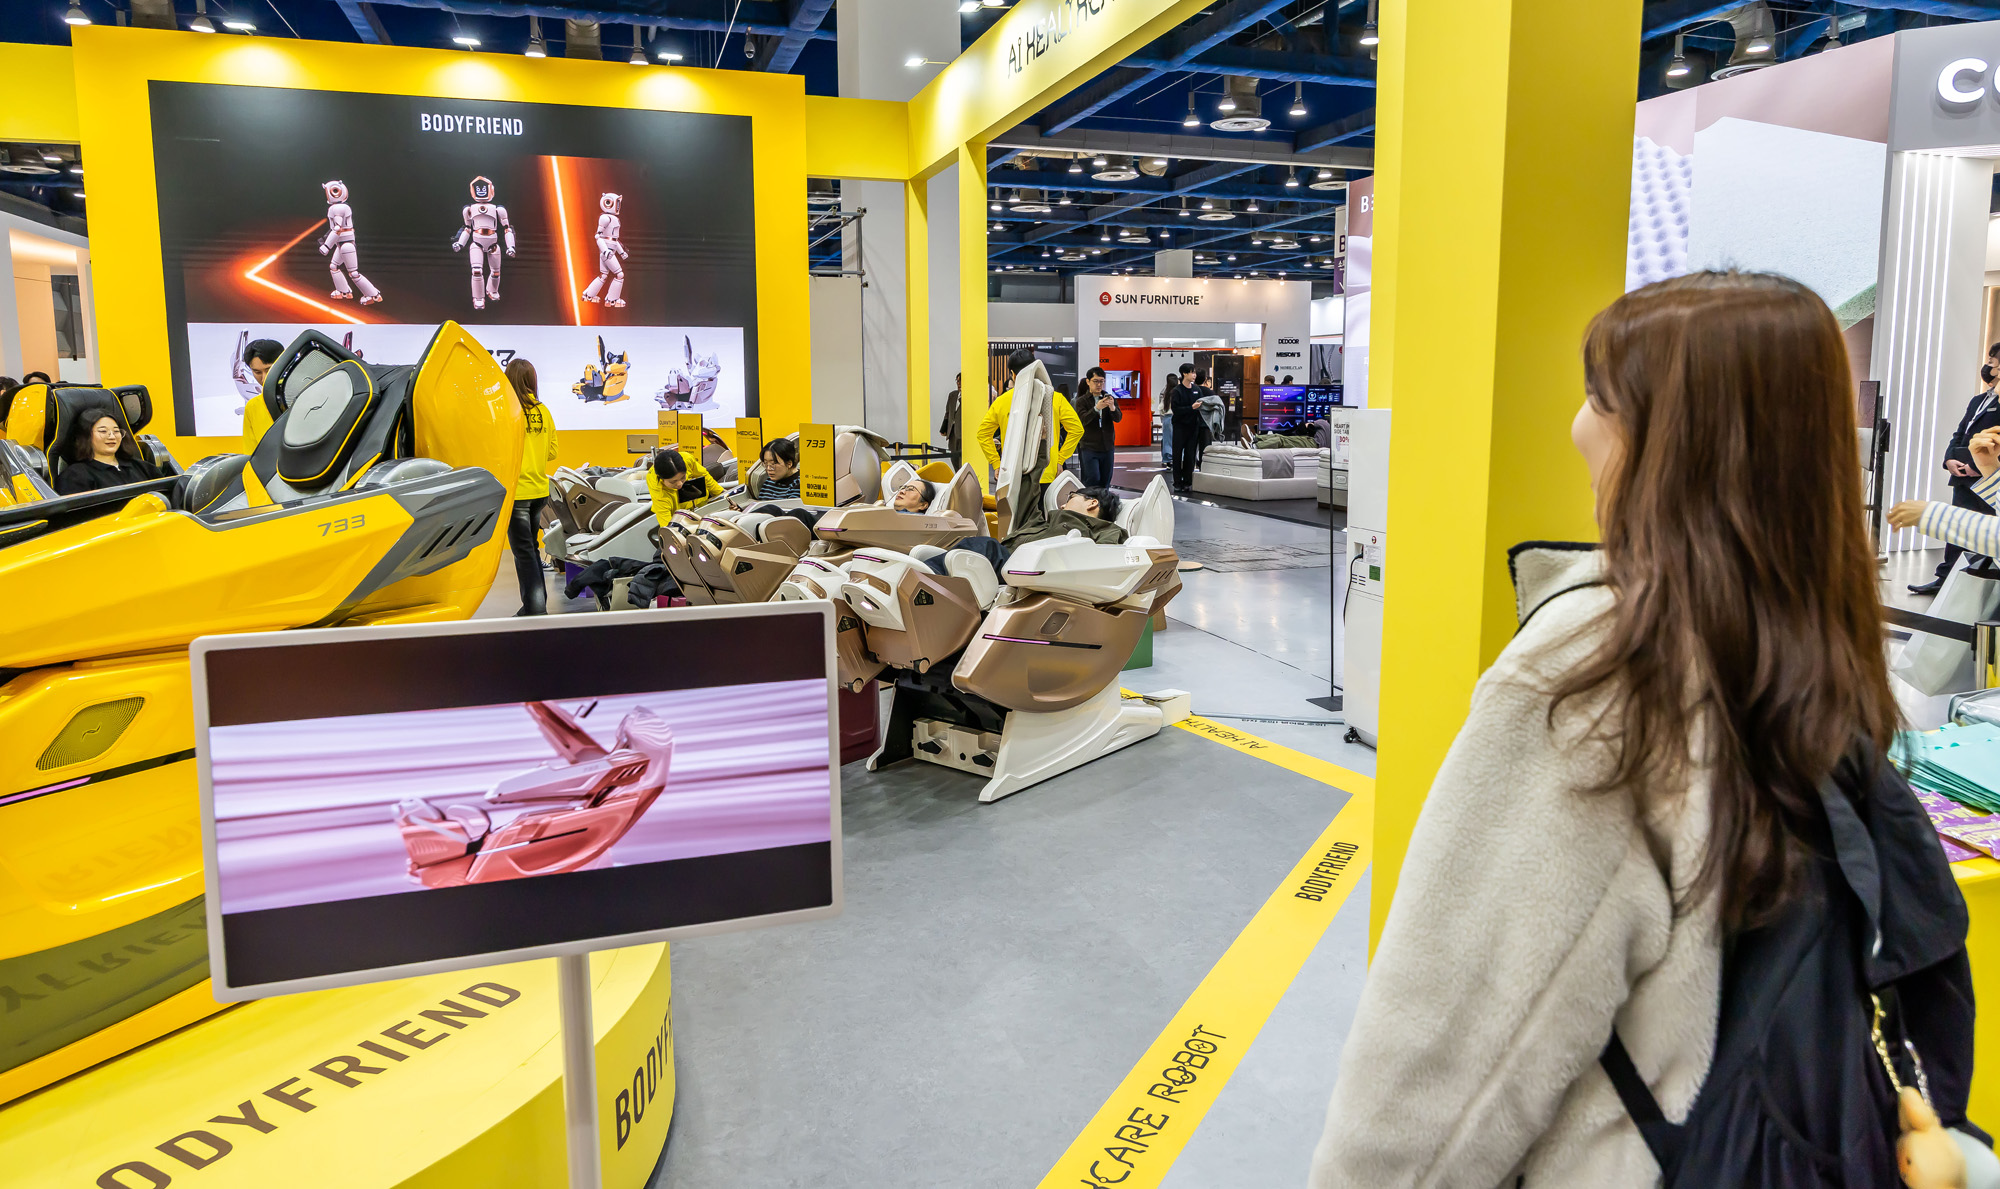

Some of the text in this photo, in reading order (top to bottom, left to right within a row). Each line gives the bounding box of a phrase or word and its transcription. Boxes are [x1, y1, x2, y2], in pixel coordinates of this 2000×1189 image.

[1008, 0, 1114, 79] AI HEALTHC
[1937, 58, 2000, 103] C
[420, 113, 524, 137] BODYFRIEND
[1361, 194, 1374, 213] B
[1115, 294, 1200, 305] SUN FURNITURE
[805, 439, 826, 449] 733
[317, 514, 366, 537] 733
[1181, 717, 1242, 743] HEALTH
[1294, 841, 1360, 902] BODYFRIEND
[1147, 1024, 1227, 1104] ROBOT
[96, 981, 522, 1189] ODYFRIEND
